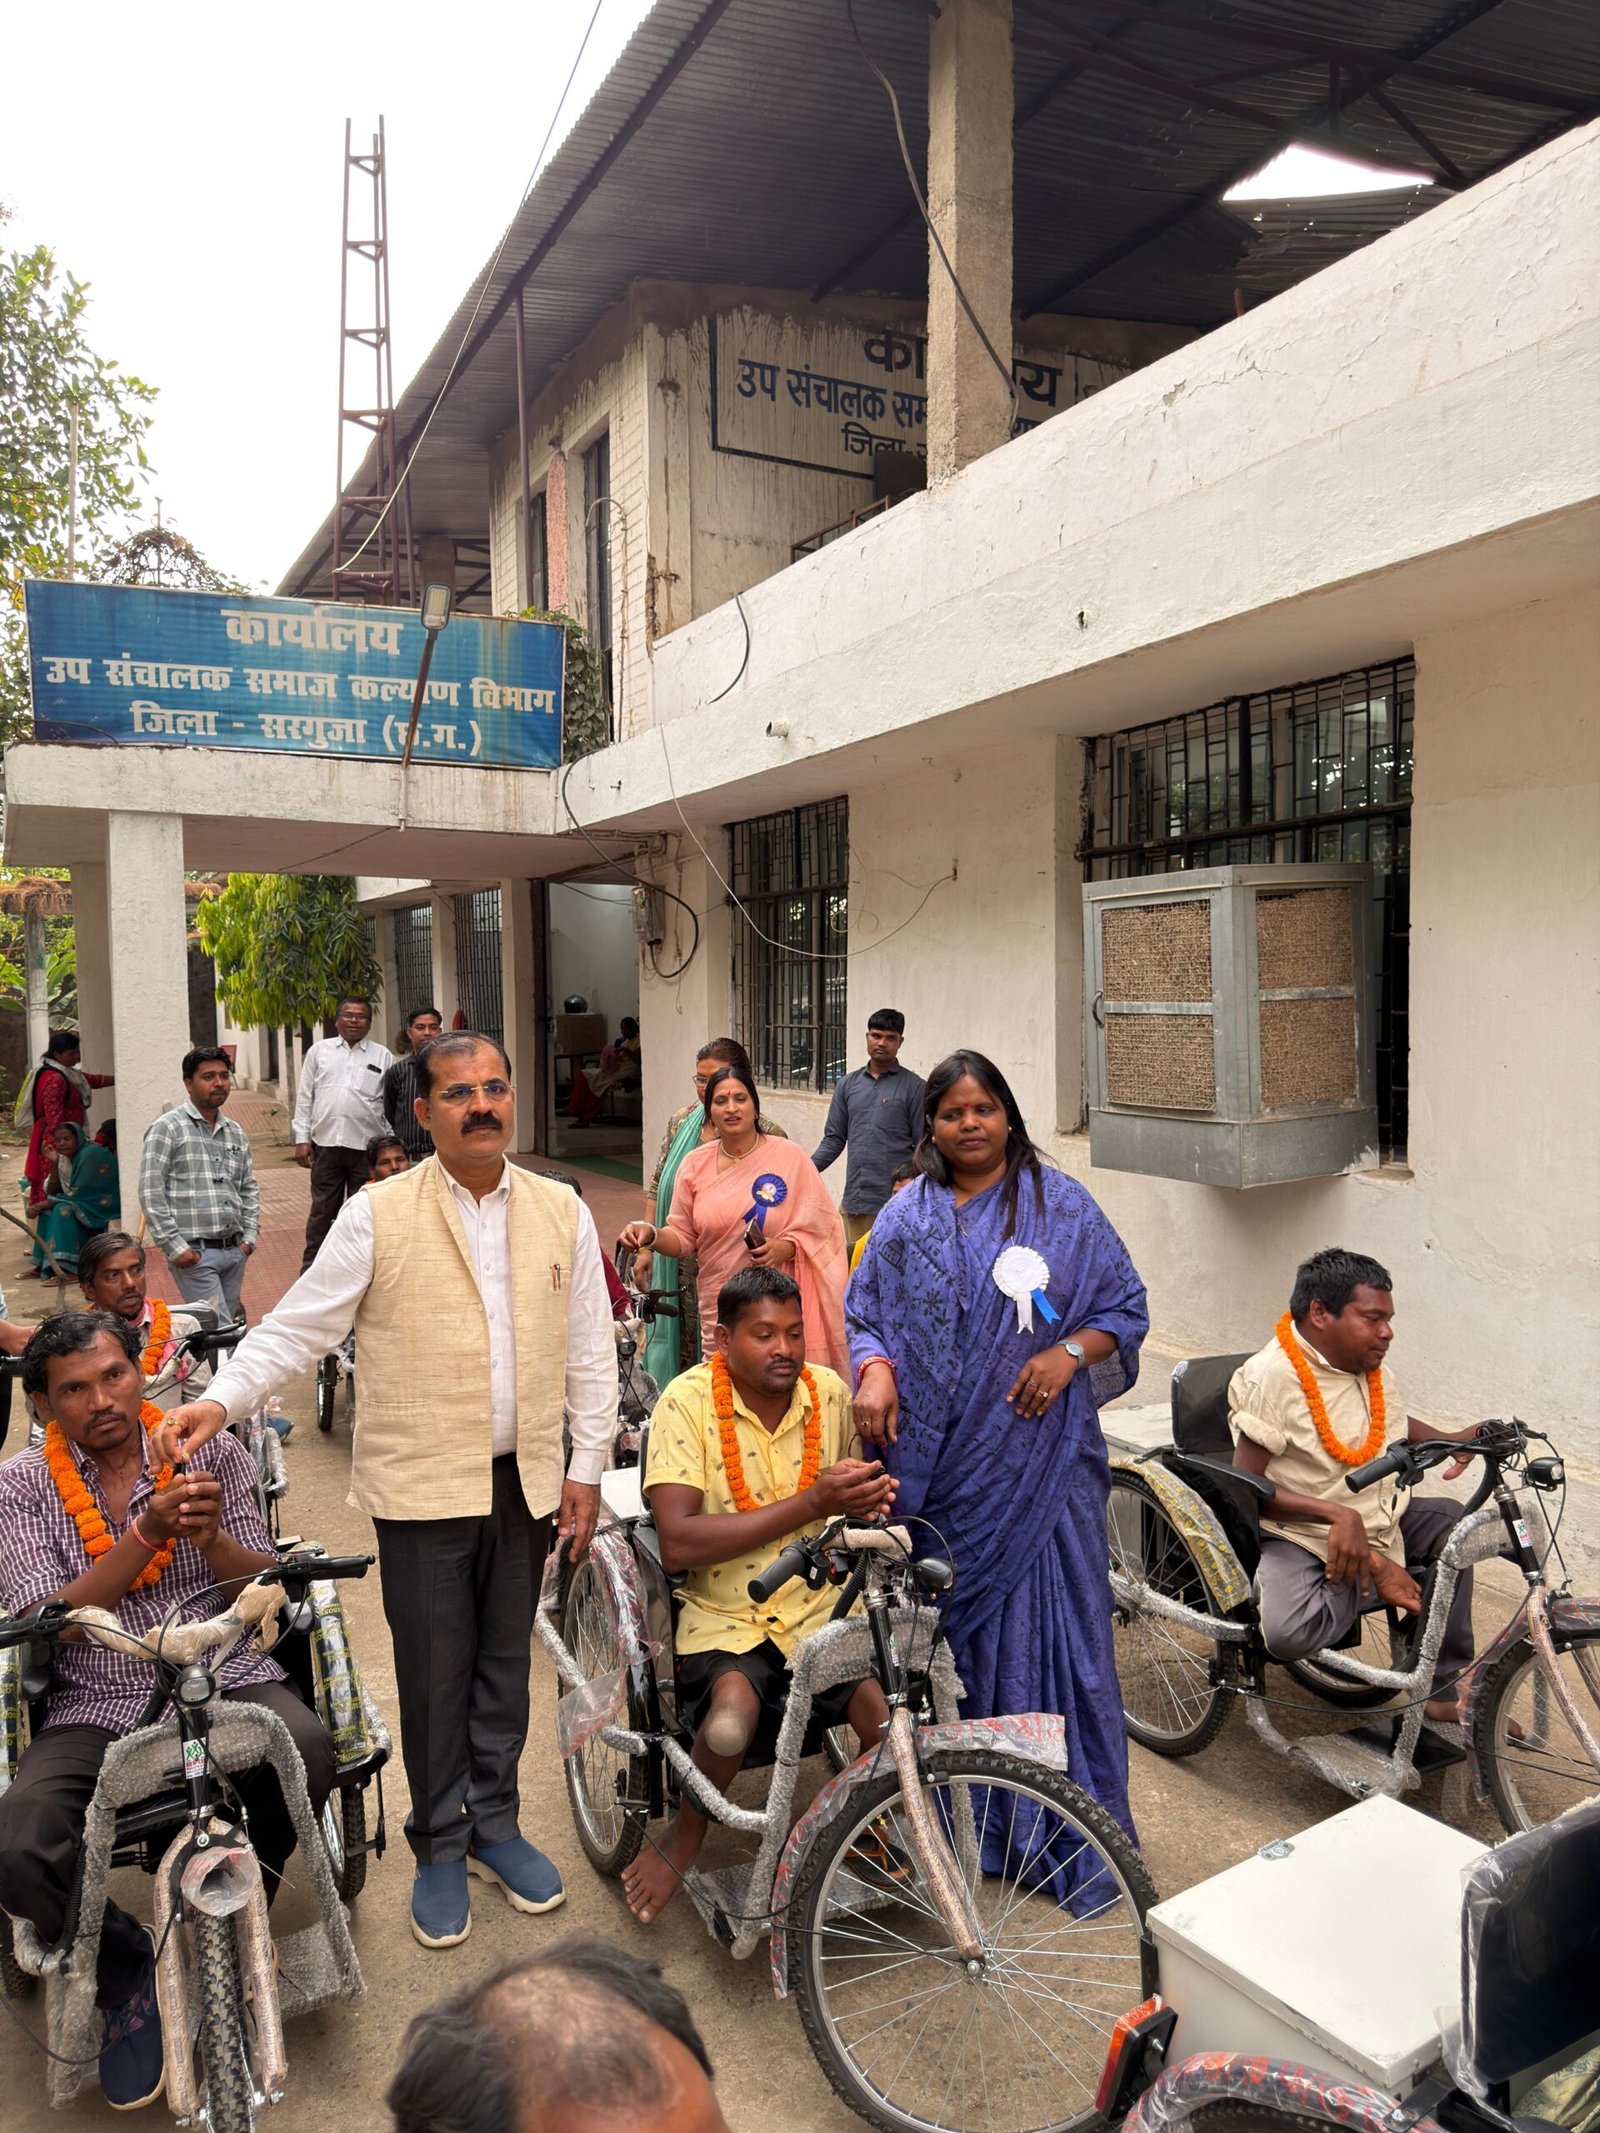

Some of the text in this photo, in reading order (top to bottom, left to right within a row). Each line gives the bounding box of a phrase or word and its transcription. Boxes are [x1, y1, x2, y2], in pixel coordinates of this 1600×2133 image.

[737, 358, 781, 402] उप
[787, 363, 887, 421] संचालक
[221, 605, 404, 655] कार्यालय
[42, 652, 556, 714] उप संचालक समाज कल्याण विभाग
[129, 700, 220, 736] जिला
[258, 713, 368, 749] सरगुजा
